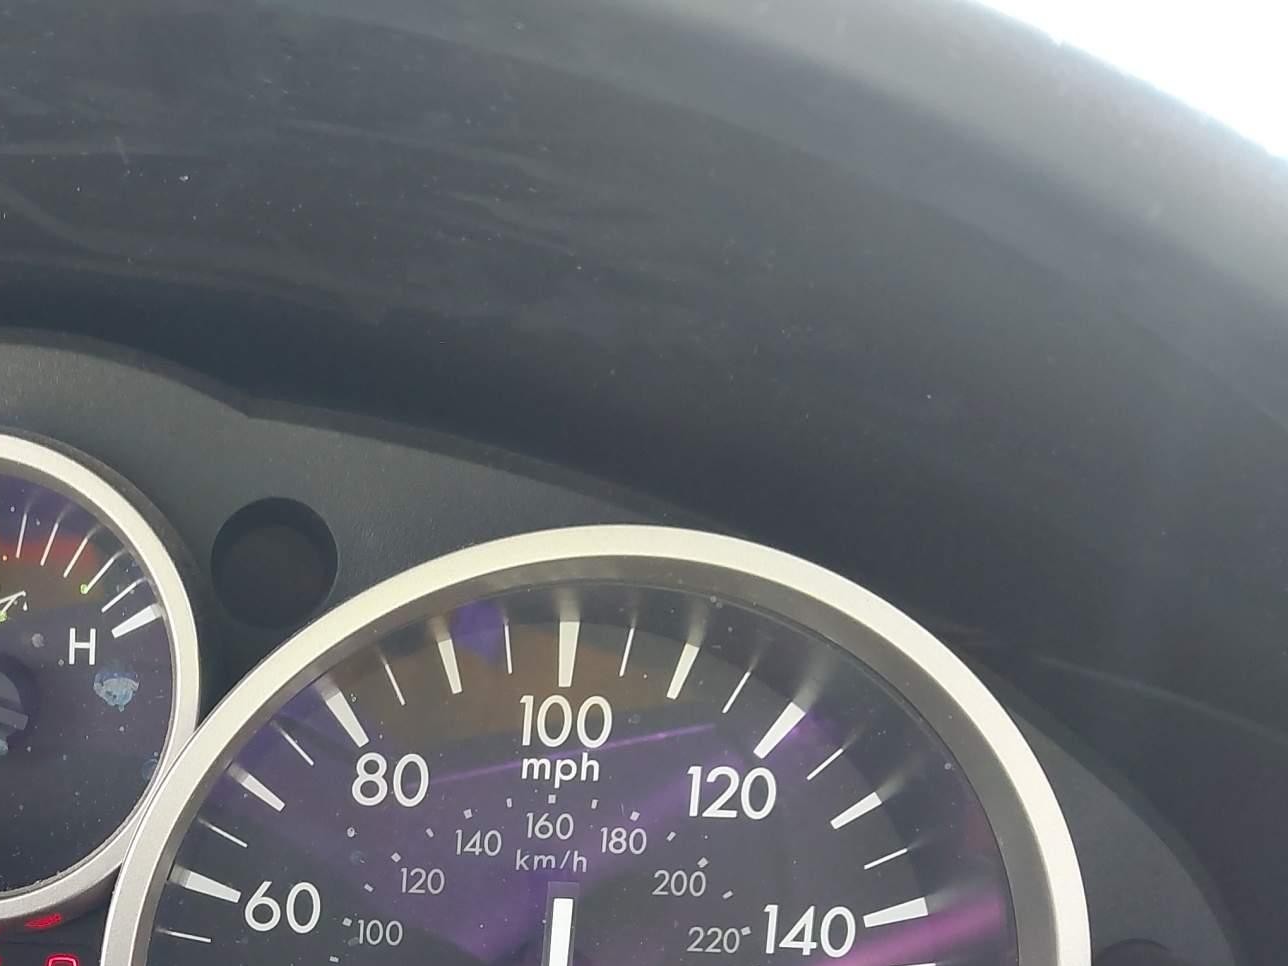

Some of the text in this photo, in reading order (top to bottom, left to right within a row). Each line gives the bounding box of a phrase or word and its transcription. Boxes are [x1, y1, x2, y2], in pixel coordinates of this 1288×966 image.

[68, 627, 97, 666] H
[519, 694, 613, 749] 100
[351, 752, 430, 808] 80
[521, 752, 600, 789] mph
[686, 765, 777, 820] 120
[525, 812, 575, 841] 160
[599, 826, 648, 855] 180
[454, 829, 503, 857] 140
[515, 849, 588, 873] km/h
[400, 867, 446, 895] 120
[652, 869, 707, 897] 200
[244, 881, 321, 934] 60
[357, 919, 404, 946] 100
[686, 926, 740, 954] 220
[763, 904, 857, 959] 140
